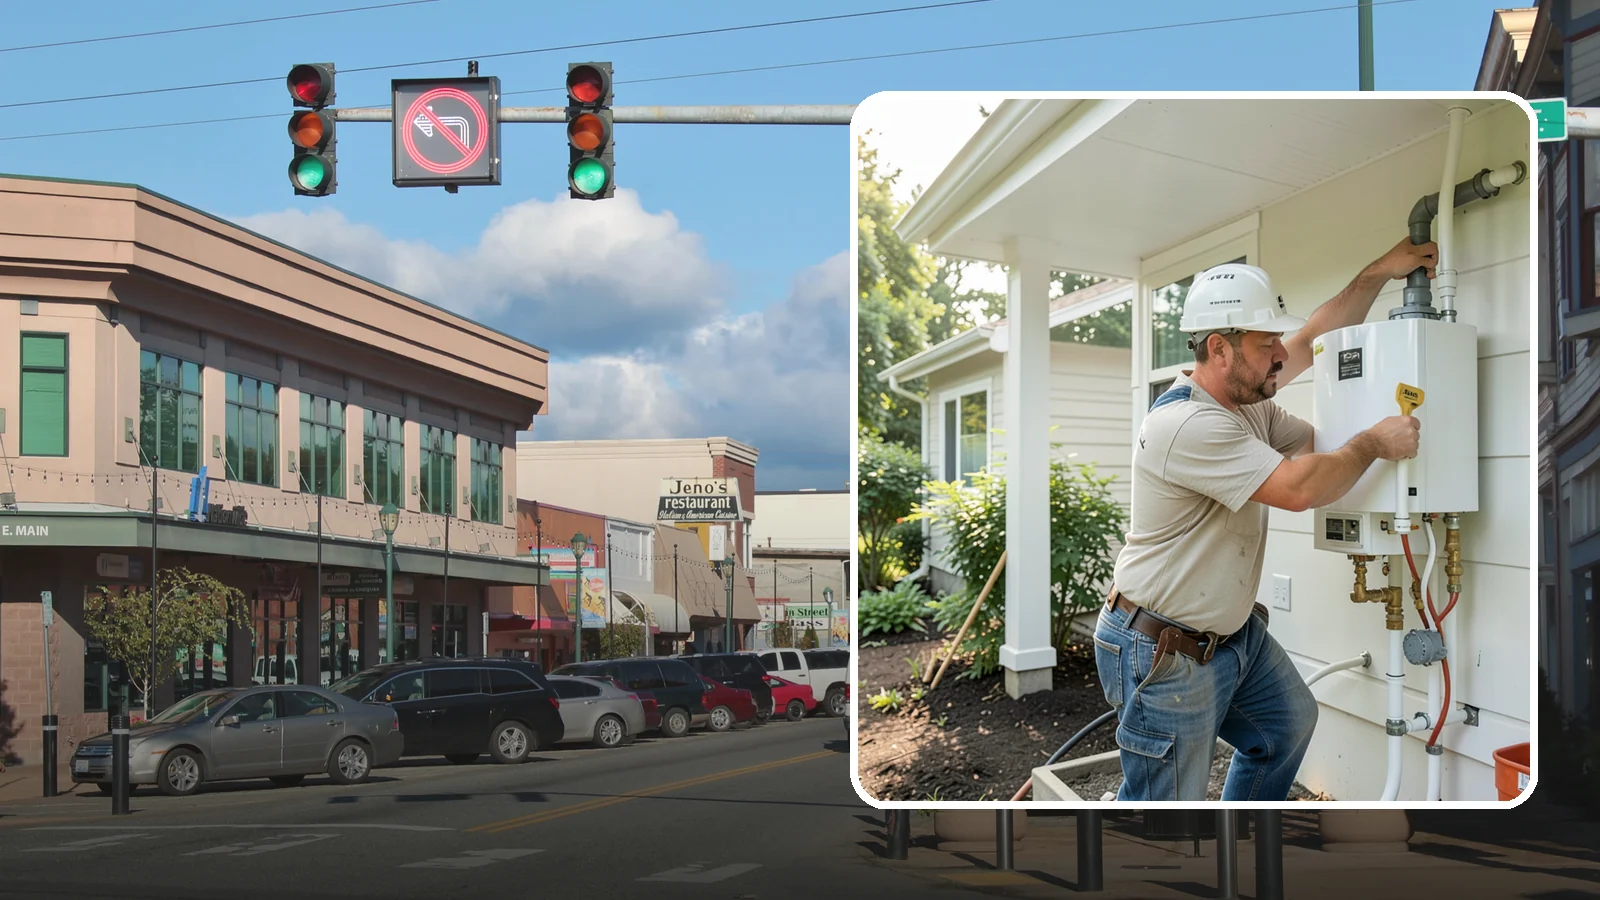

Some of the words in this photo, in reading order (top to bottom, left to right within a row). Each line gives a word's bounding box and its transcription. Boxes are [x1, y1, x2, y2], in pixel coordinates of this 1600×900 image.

[669, 480, 727, 494] Jeno's
[665, 496, 731, 509] restaurant
[658, 510, 681, 519] Italian
[686, 510, 714, 519] American
[715, 510, 737, 520] Cuisine
[2, 525, 13, 536] E.
[15, 525, 49, 536] MAIN
[786, 608, 794, 616] in
[797, 607, 829, 617] Street
[791, 619, 823, 627] lass
